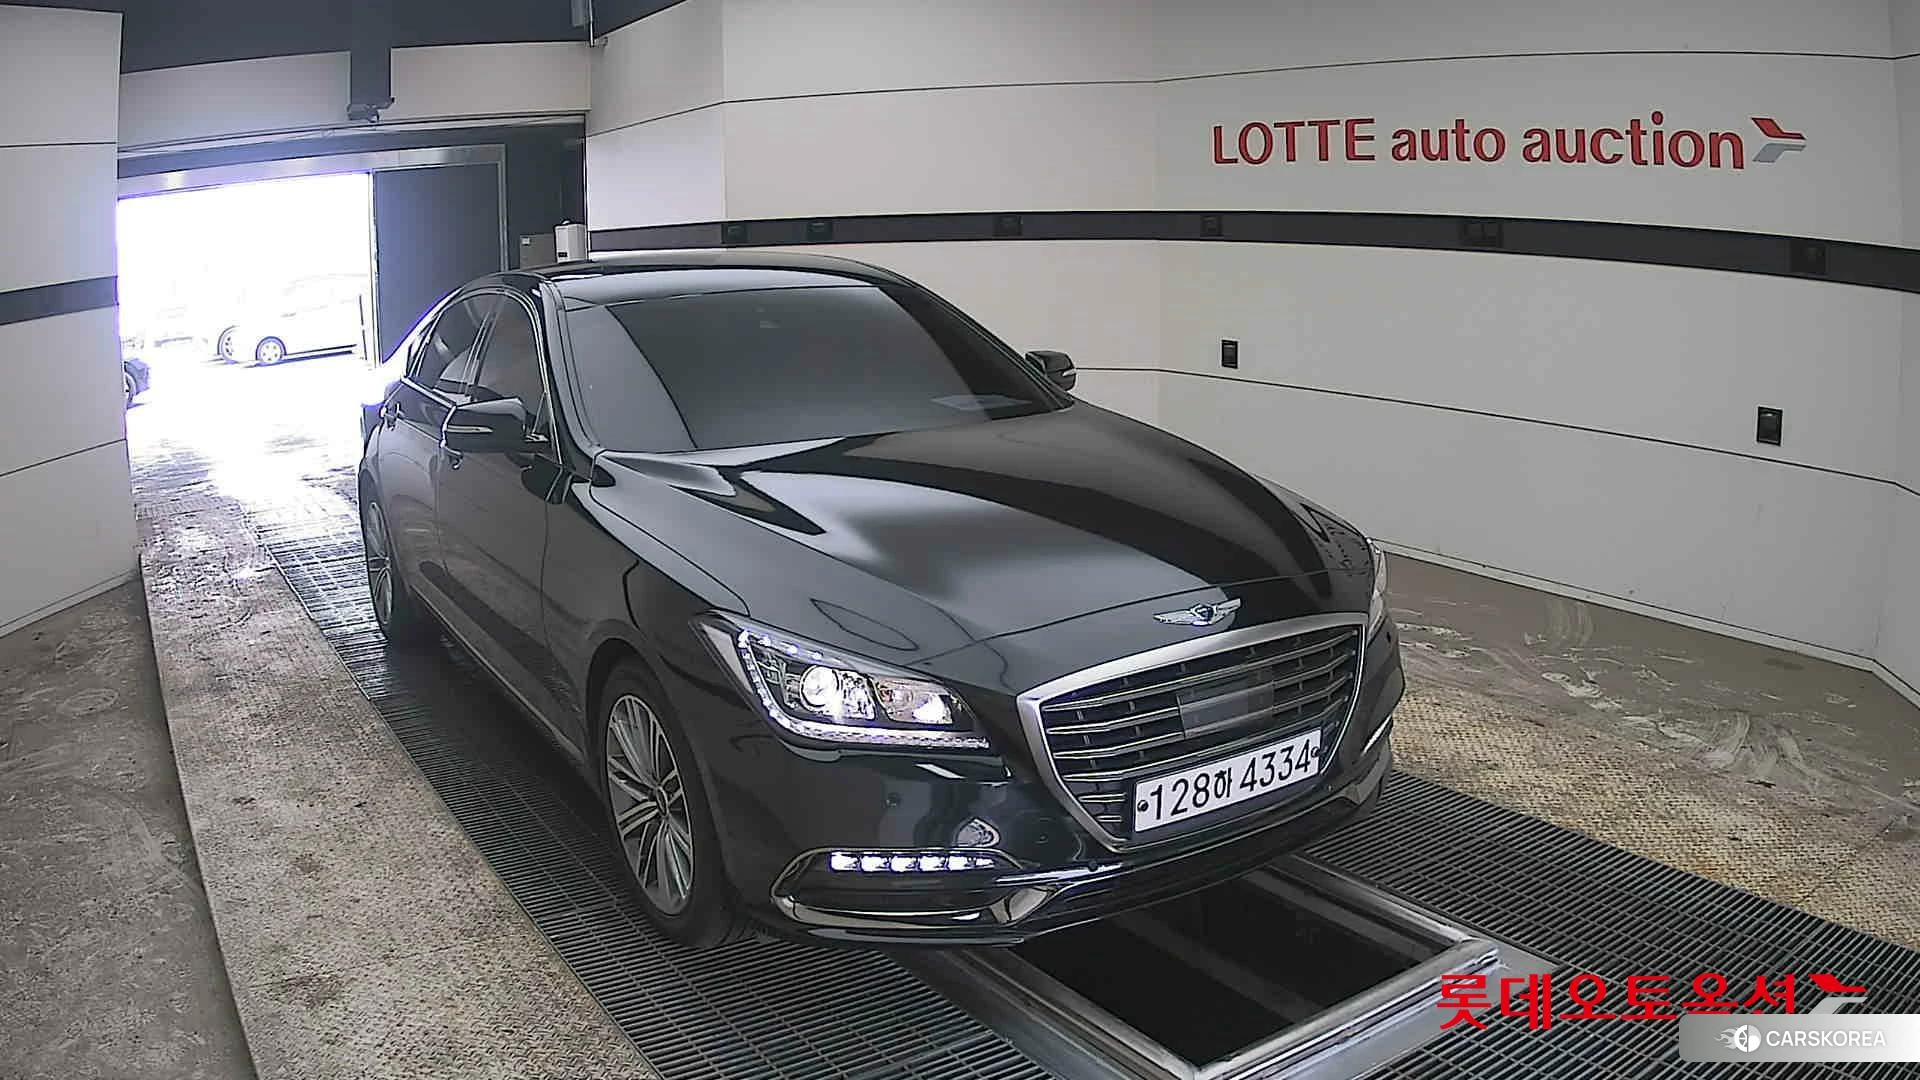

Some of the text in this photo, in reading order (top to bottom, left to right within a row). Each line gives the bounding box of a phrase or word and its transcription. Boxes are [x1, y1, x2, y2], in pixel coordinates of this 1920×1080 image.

[1212, 111, 1745, 169] LOTTE auto auction
[1150, 738, 1312, 820] 128하 4334
